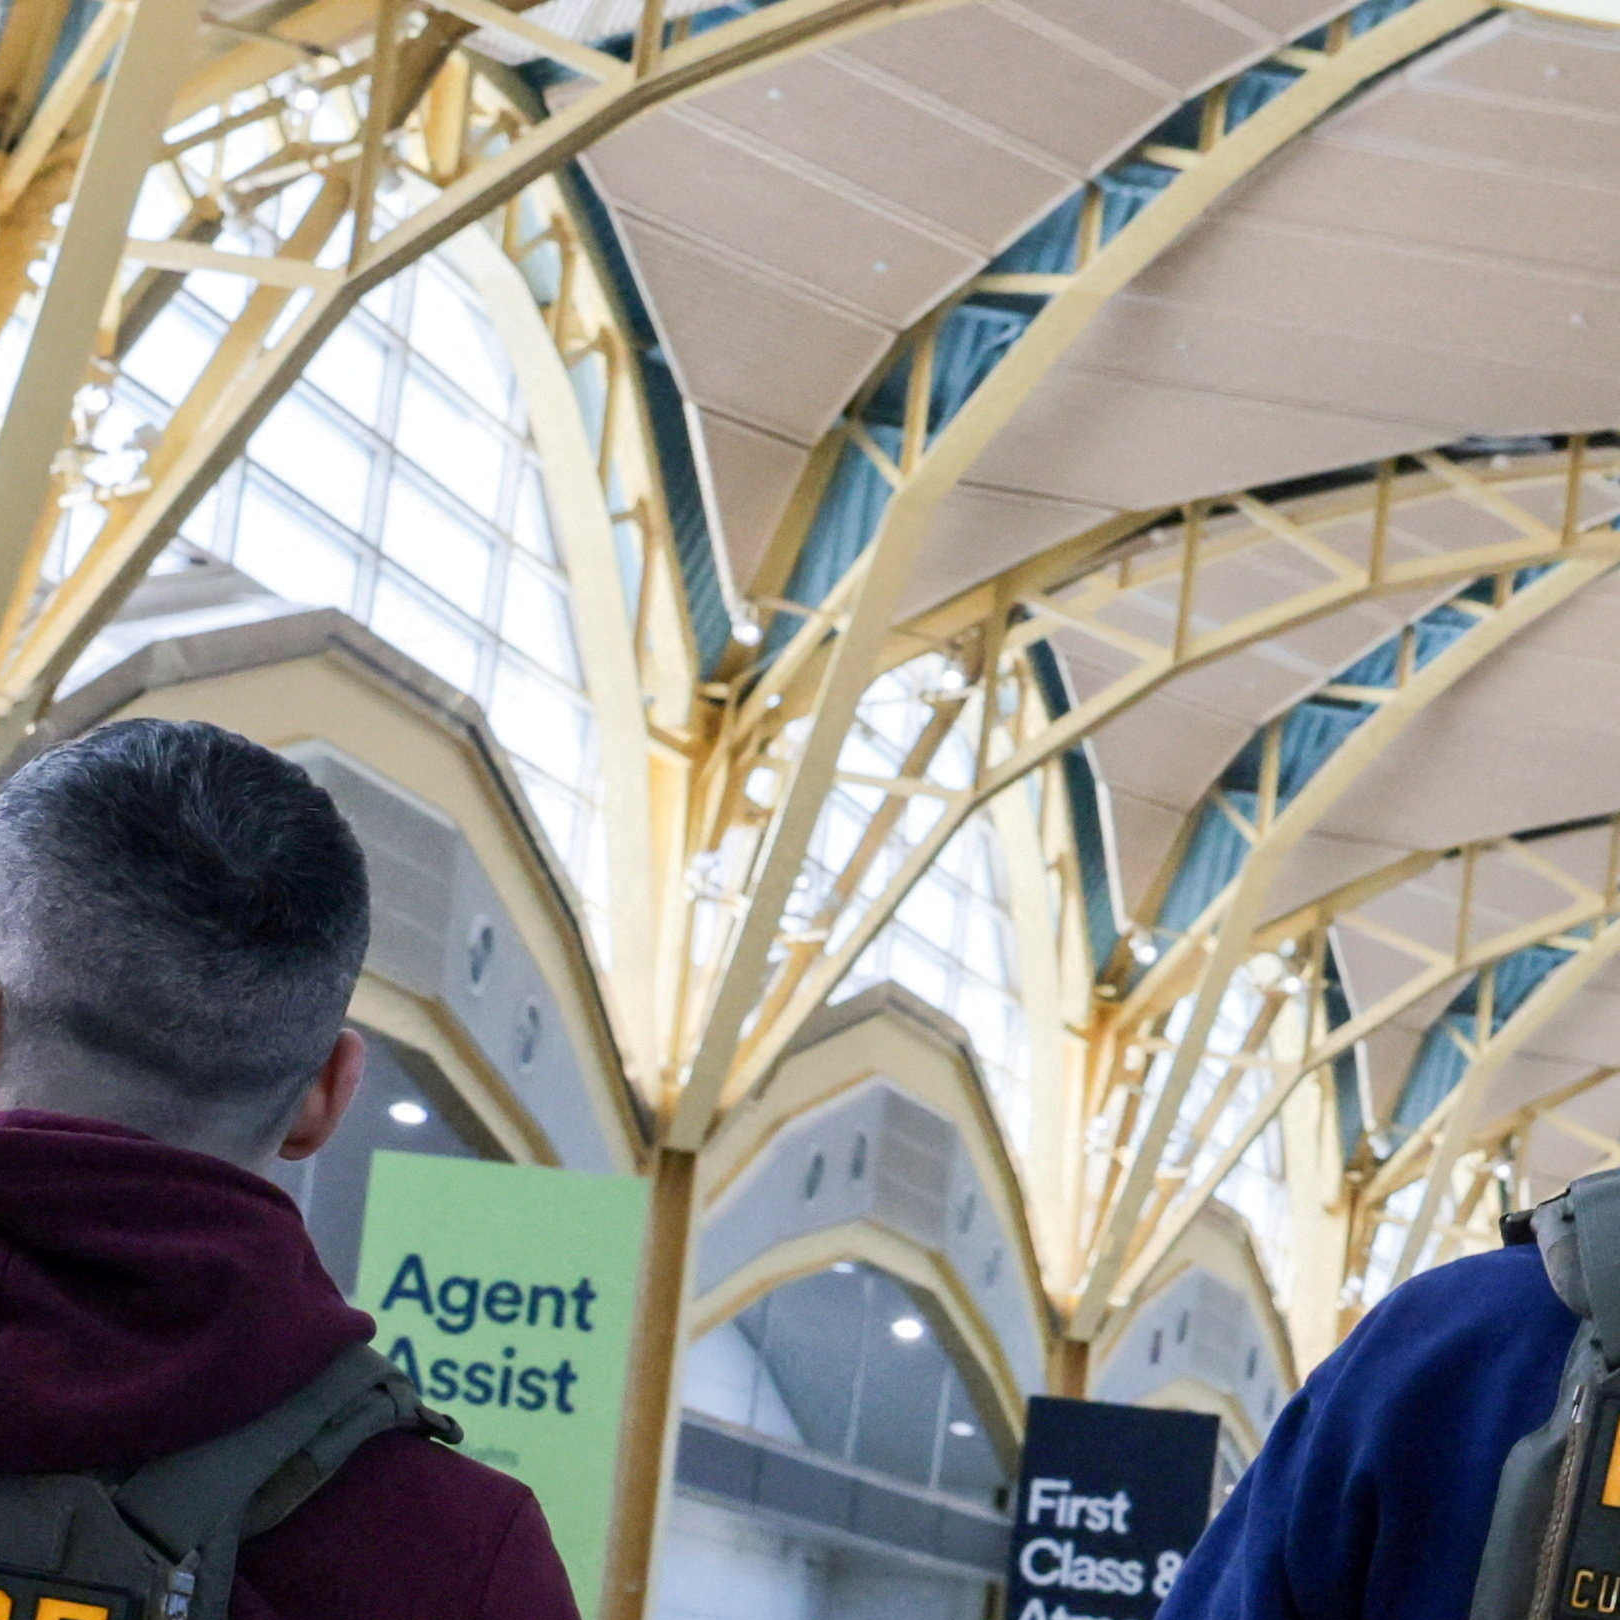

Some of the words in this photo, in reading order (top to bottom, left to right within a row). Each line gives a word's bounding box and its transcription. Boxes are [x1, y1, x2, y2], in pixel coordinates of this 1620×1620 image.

[381, 1253, 597, 1335] Agent
[387, 1336, 578, 1414] Assist
[1027, 1477, 1130, 1534] First
[1019, 1537, 1144, 1596] Class
